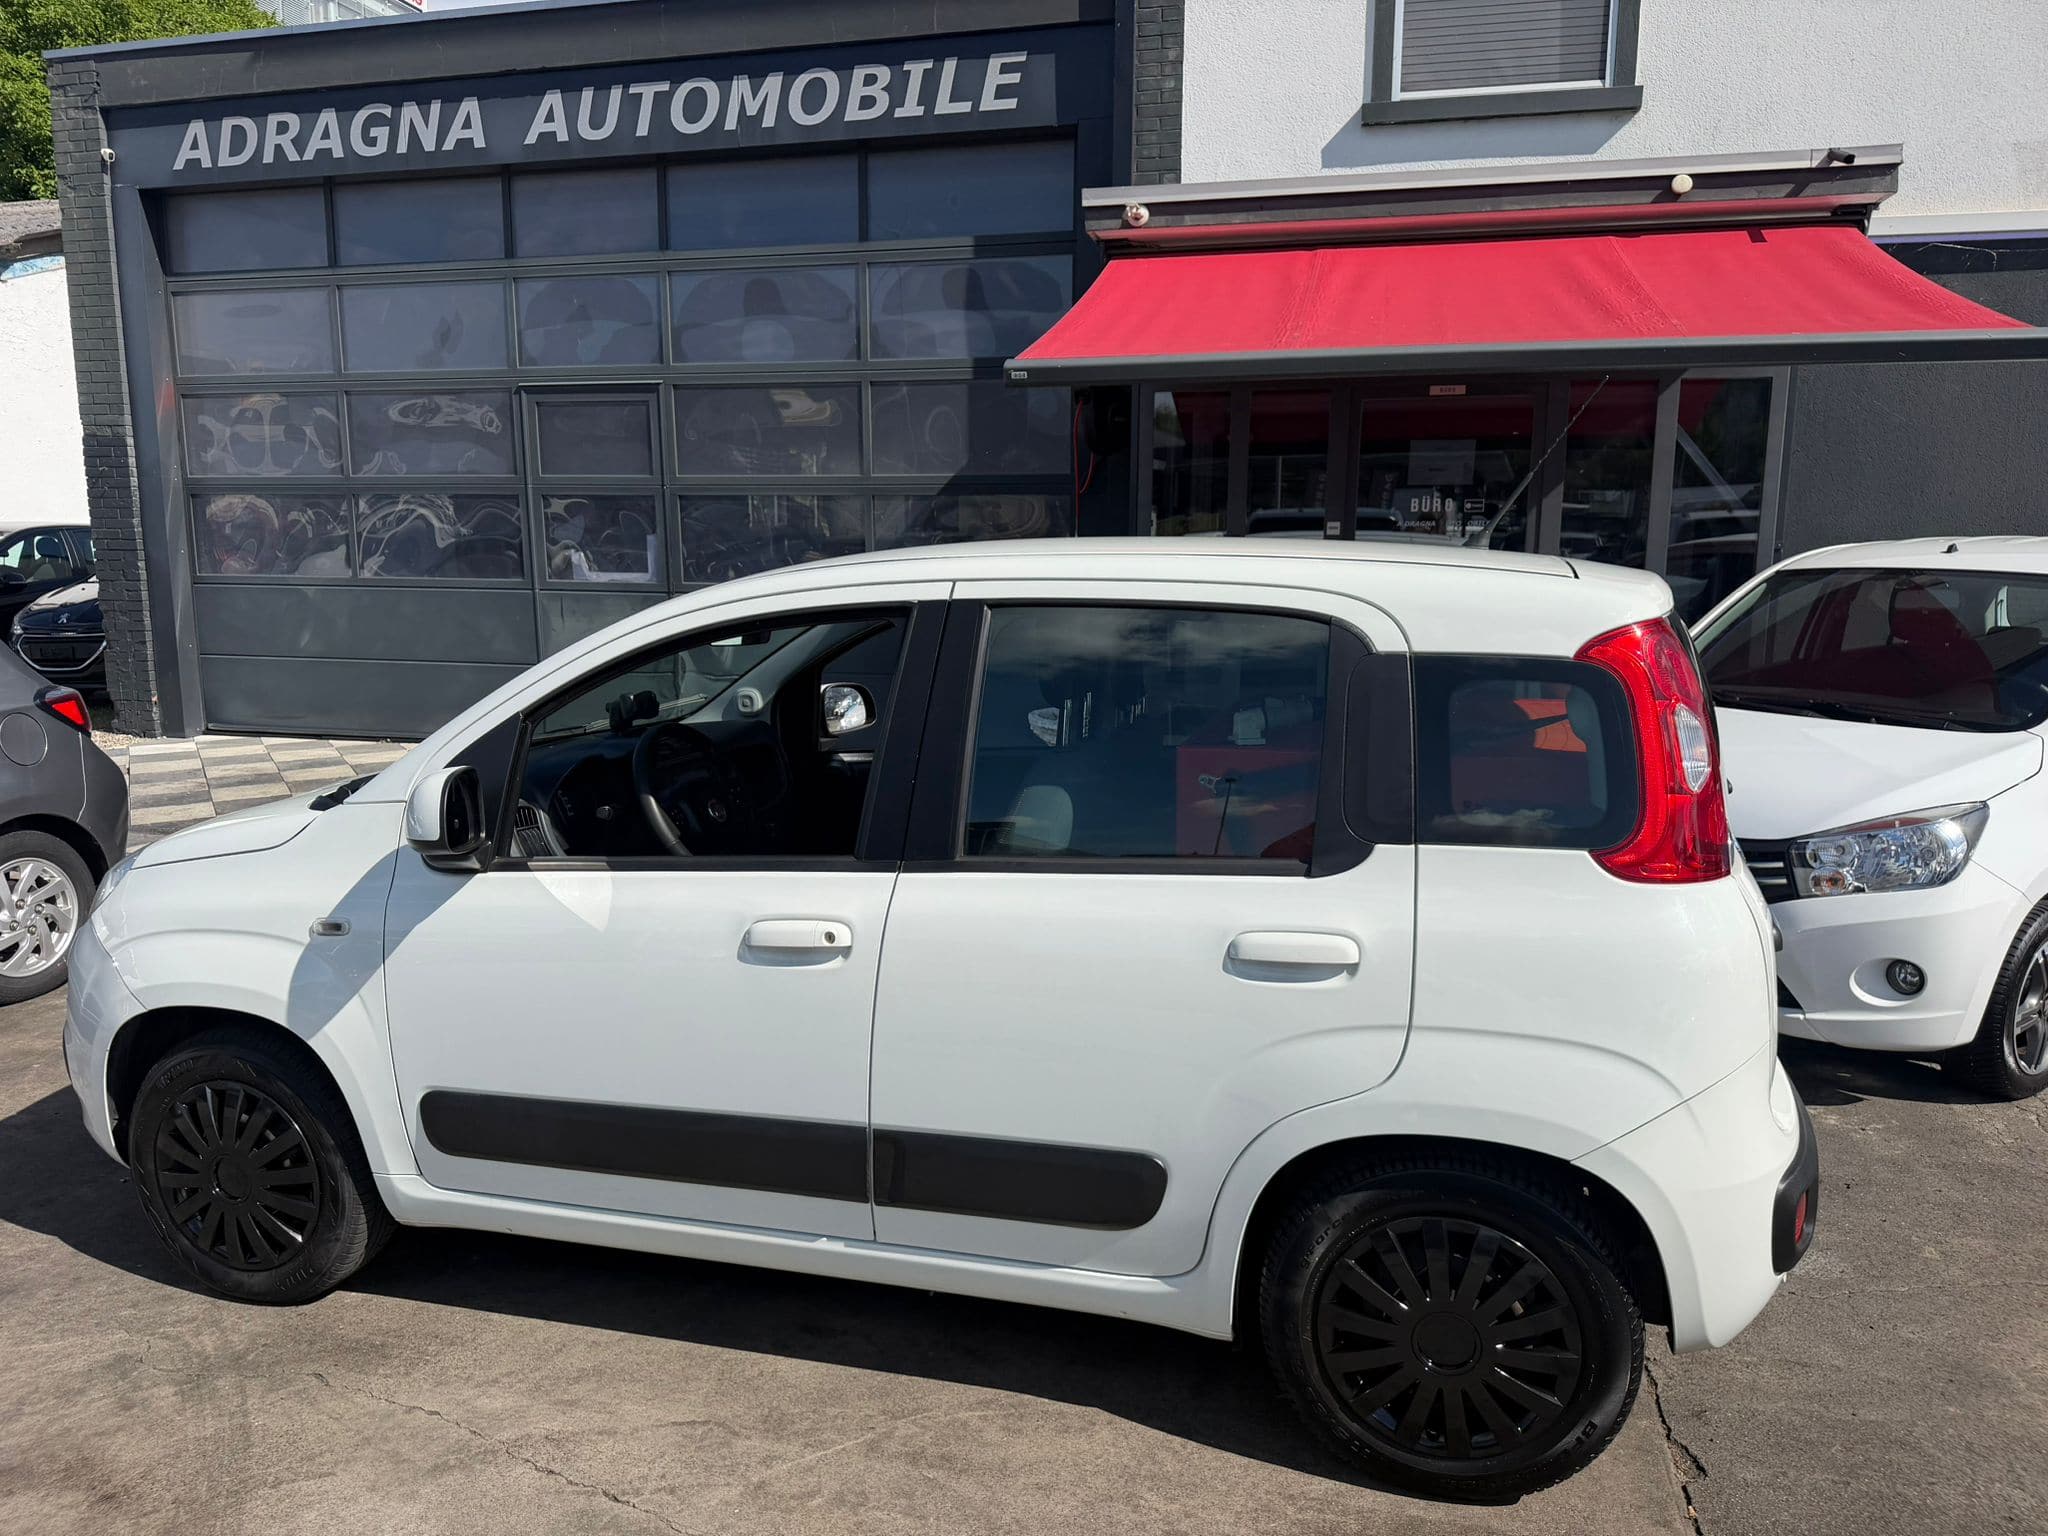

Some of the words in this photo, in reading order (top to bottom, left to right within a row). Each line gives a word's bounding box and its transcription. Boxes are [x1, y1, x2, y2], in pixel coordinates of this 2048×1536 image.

[172, 96, 487, 170] ADRAGNA
[523, 51, 1028, 145] AUTOMOBILE
[1410, 495, 1453, 513] BÜRO
